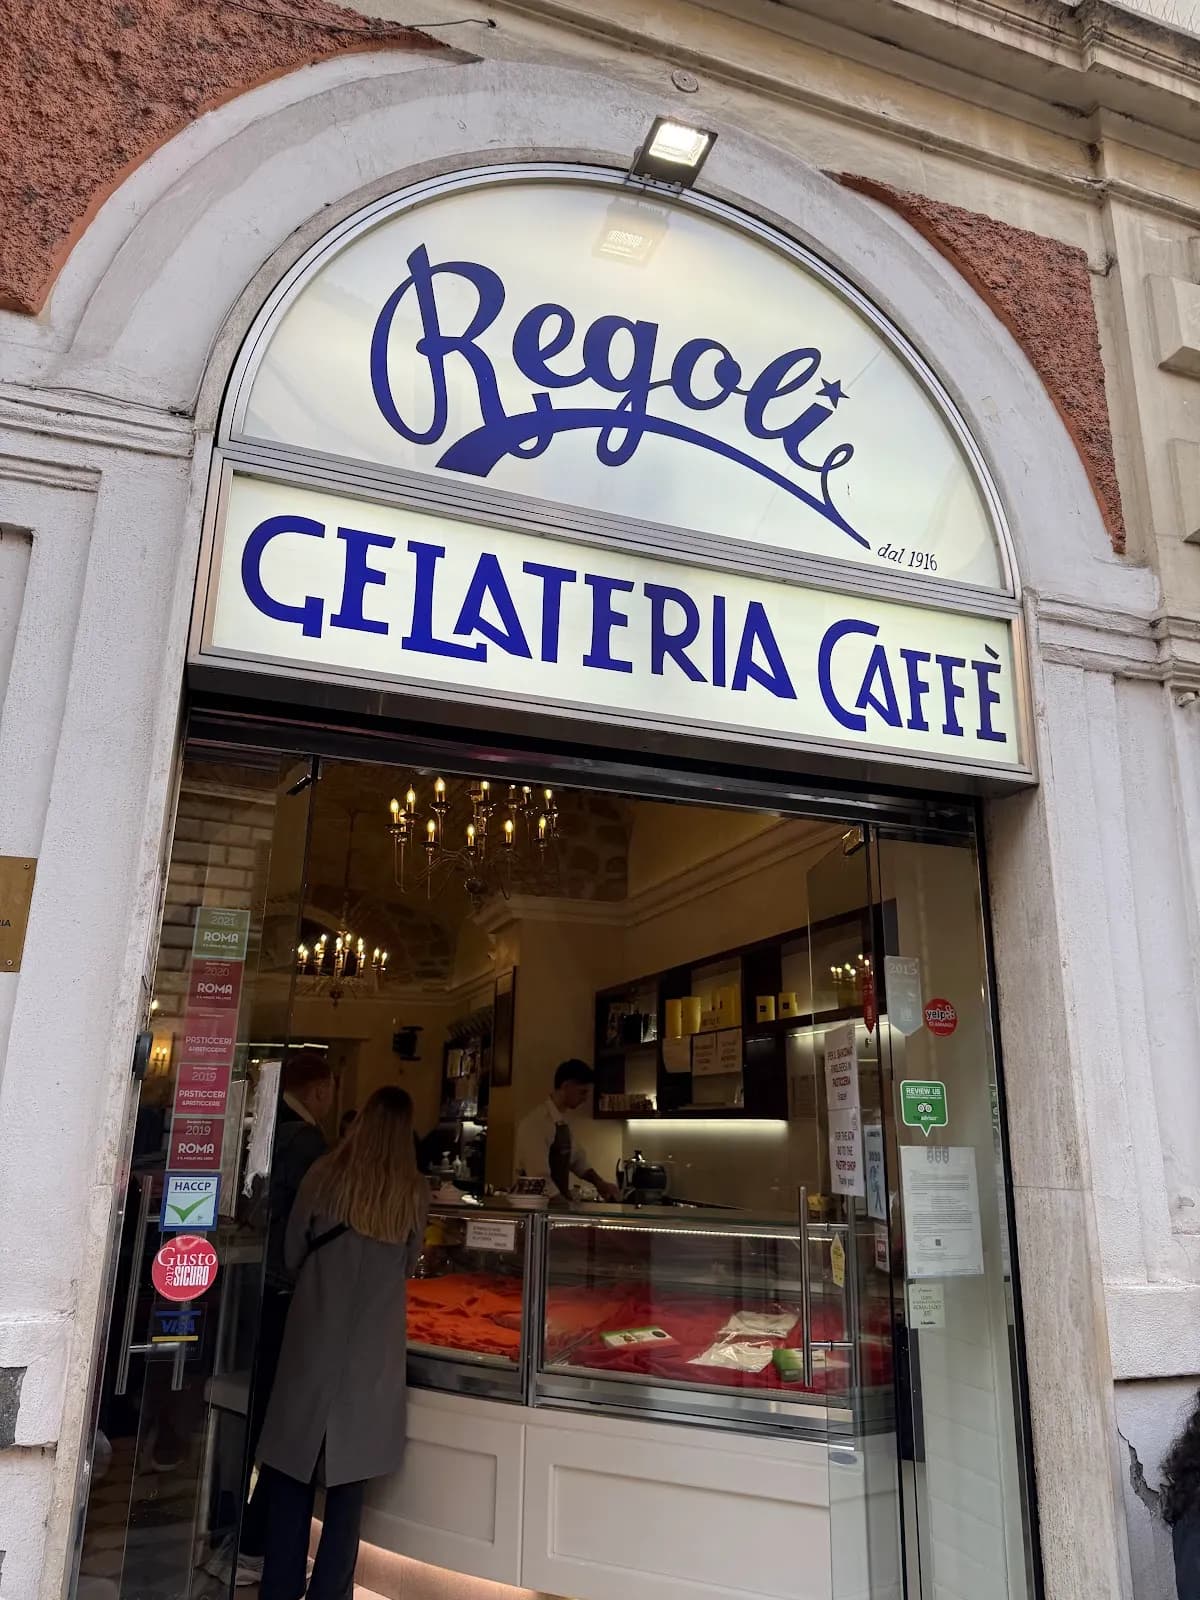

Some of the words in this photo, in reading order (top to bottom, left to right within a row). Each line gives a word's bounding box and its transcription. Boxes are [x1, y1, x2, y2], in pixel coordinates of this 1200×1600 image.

[371, 243, 871, 552] Regoli
[877, 543, 905, 563] dal
[908, 551, 938, 571] 1916
[241, 515, 796, 700] GELATERIA
[818, 617, 1008, 743] CAFFÈ
[203, 931, 239, 943] ROMA
[197, 982, 233, 994] ROMA
[926, 1008, 946, 1021] yelp
[185, 1035, 232, 1045] PASTICCERI
[191, 1071, 217, 1082] 2019
[179, 1089, 226, 1099] PASTICCERI
[905, 1087, 931, 1095] REVIEW
[185, 1125, 211, 1136] 2019
[178, 1143, 215, 1153] ROMA
[174, 1181, 212, 1192] HACCP
[157, 1247, 217, 1266] Gusto
[164, 1265, 175, 1287] 2017
[173, 1265, 210, 1287] SICURO
[160, 1319, 196, 1333] VISA
